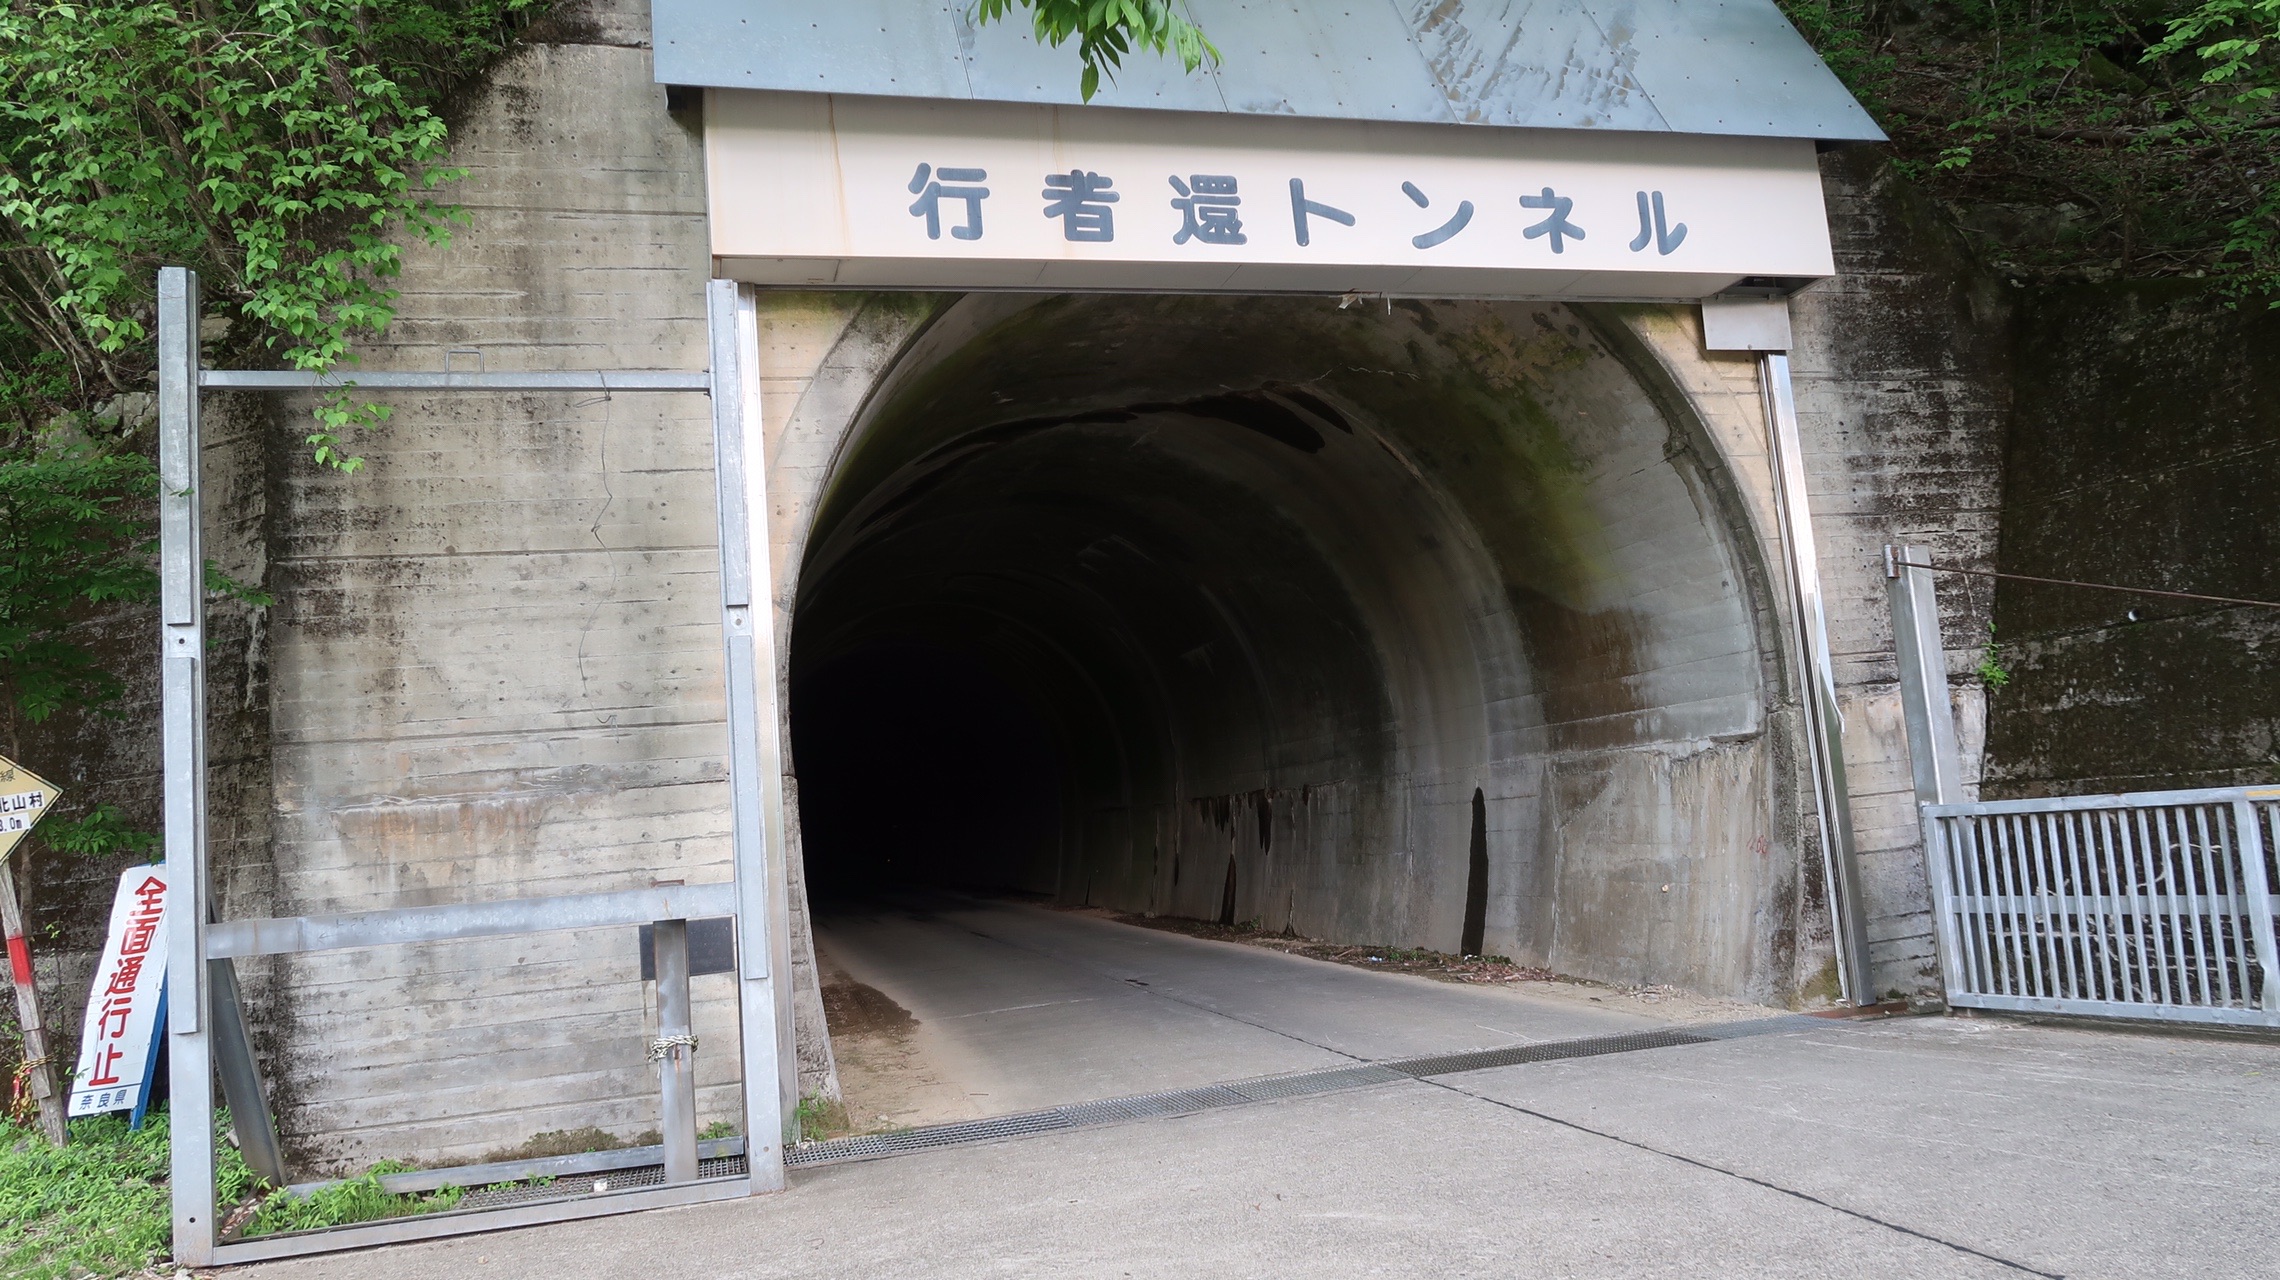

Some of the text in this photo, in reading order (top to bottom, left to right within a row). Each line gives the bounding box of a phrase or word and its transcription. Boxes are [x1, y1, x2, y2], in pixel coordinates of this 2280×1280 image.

[908, 162, 1688, 257] 行者還トンネル
[88, 876, 167, 1087] 全面通行止
[79, 1089, 127, 1111] 奈良県
